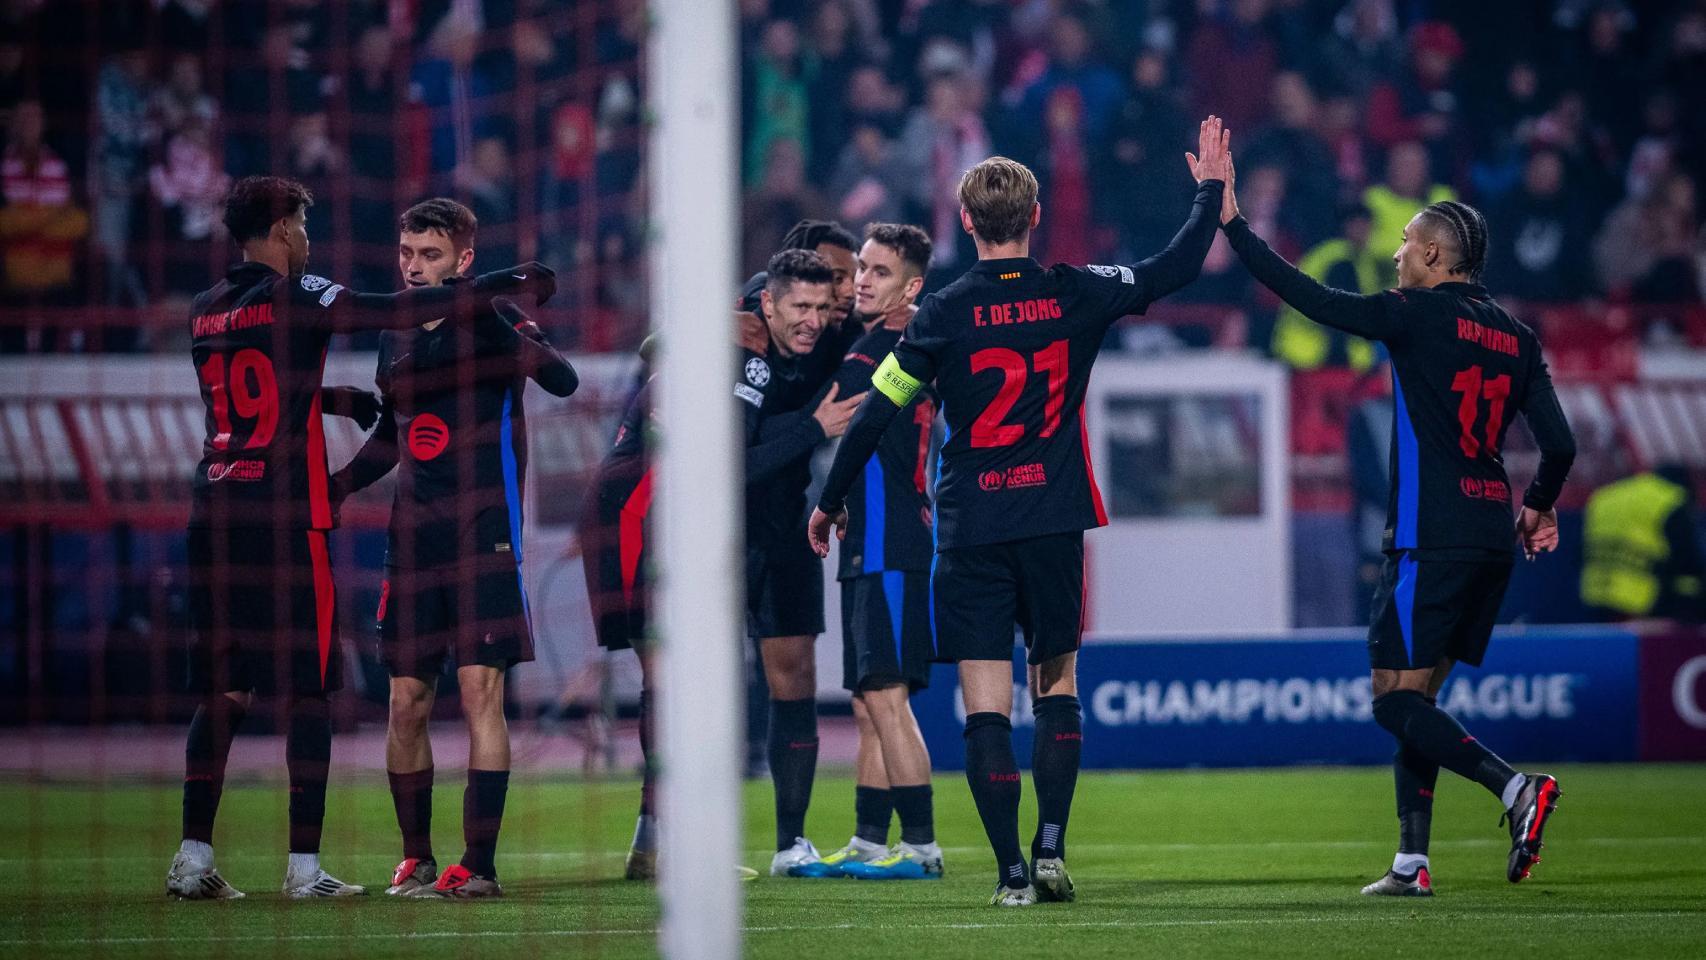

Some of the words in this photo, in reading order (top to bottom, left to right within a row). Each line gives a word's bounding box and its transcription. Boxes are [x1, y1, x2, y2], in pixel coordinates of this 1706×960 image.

[231, 303, 273, 330] YAMAL
[974, 306, 987, 327] F.
[990, 303, 1013, 326] DE
[1014, 298, 1062, 324] JONG
[200, 348, 279, 451] 19
[970, 339, 1069, 448] 21
[1451, 365, 1512, 458] 11
[1092, 677, 1374, 726] CHAMPIONS
[1442, 673, 1577, 720] AGUE
